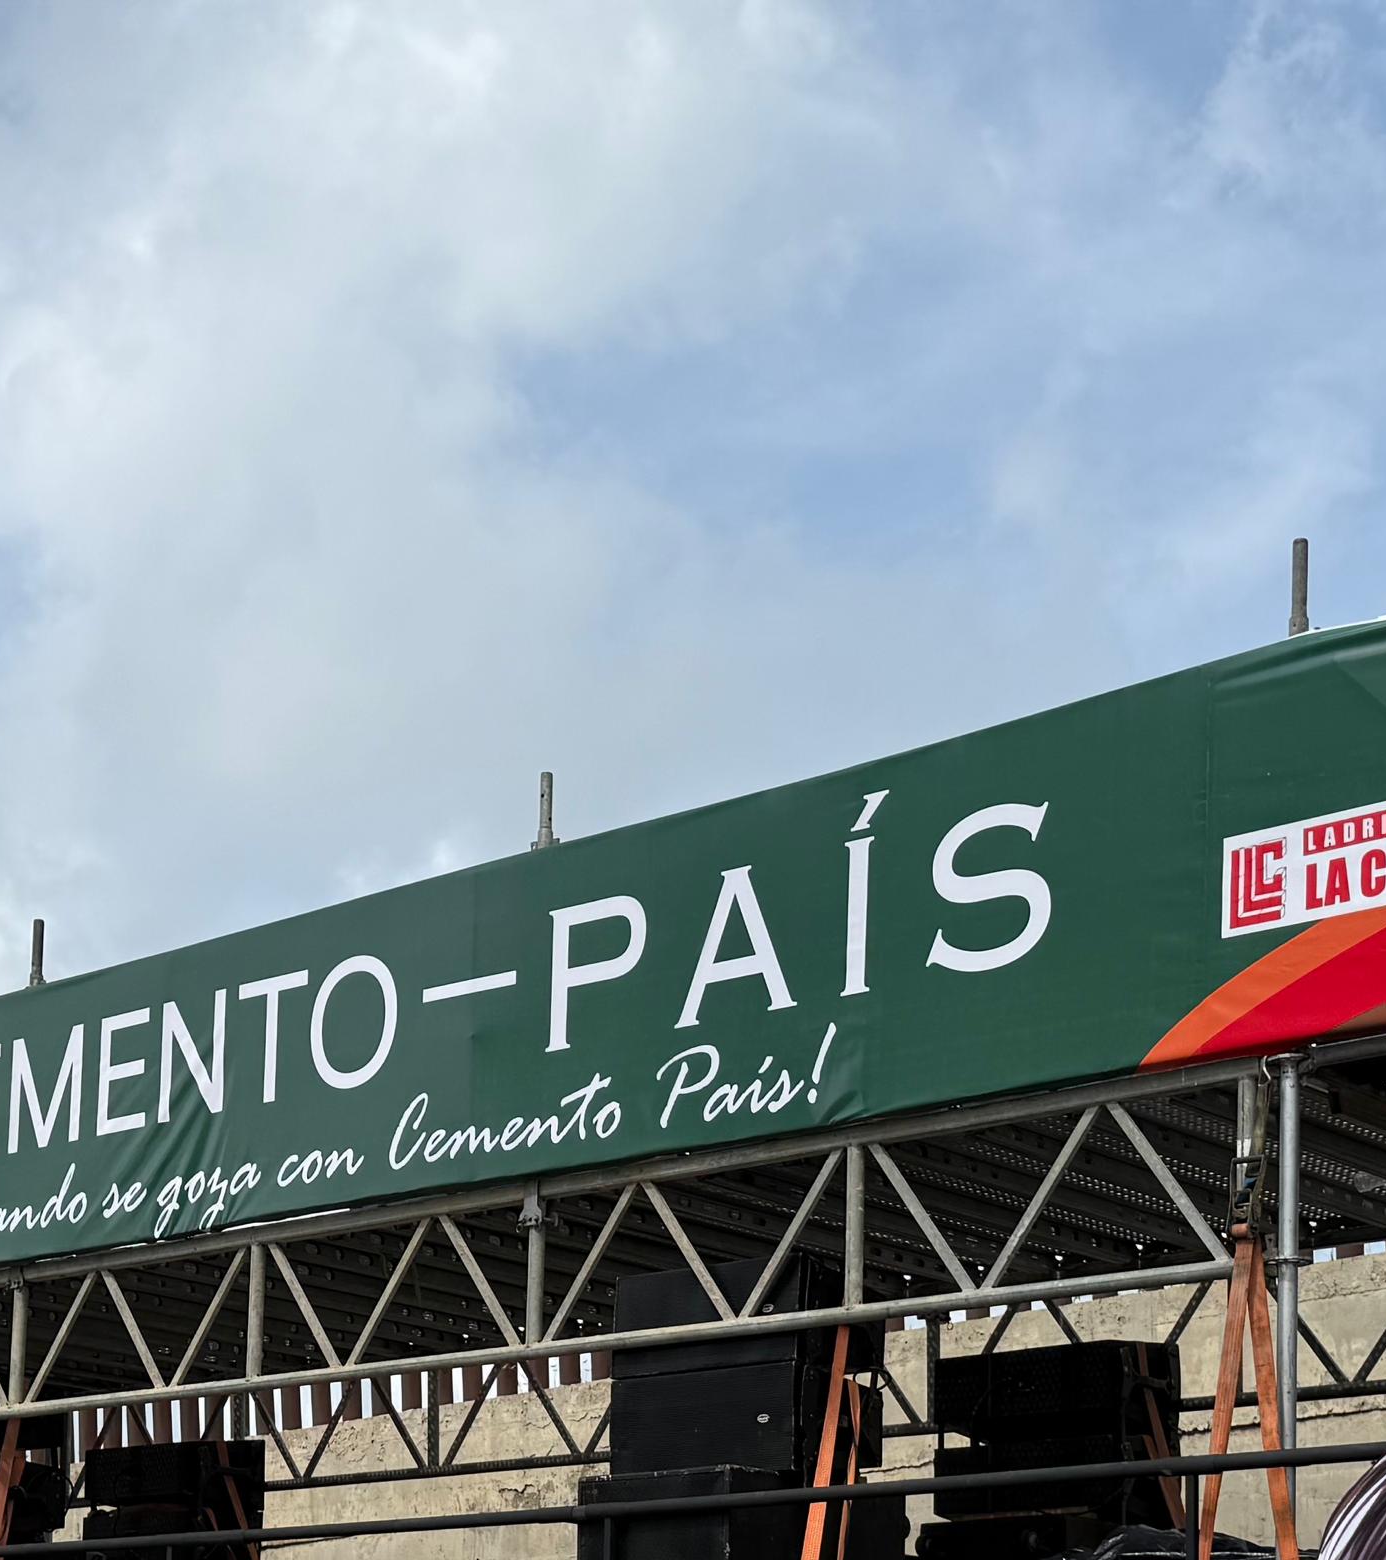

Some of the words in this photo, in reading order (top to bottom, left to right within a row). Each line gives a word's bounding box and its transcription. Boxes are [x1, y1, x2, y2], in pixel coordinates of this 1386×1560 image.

[544, 788, 1052, 1053] PAÍS
[1305, 857, 1351, 910] LA
[101, 1181, 147, 1219] se
[153, 1163, 263, 1240] goza
[276, 1147, 365, 1189] con
[387, 1072, 622, 1171] Cemento
[655, 1022, 838, 1129] País!
